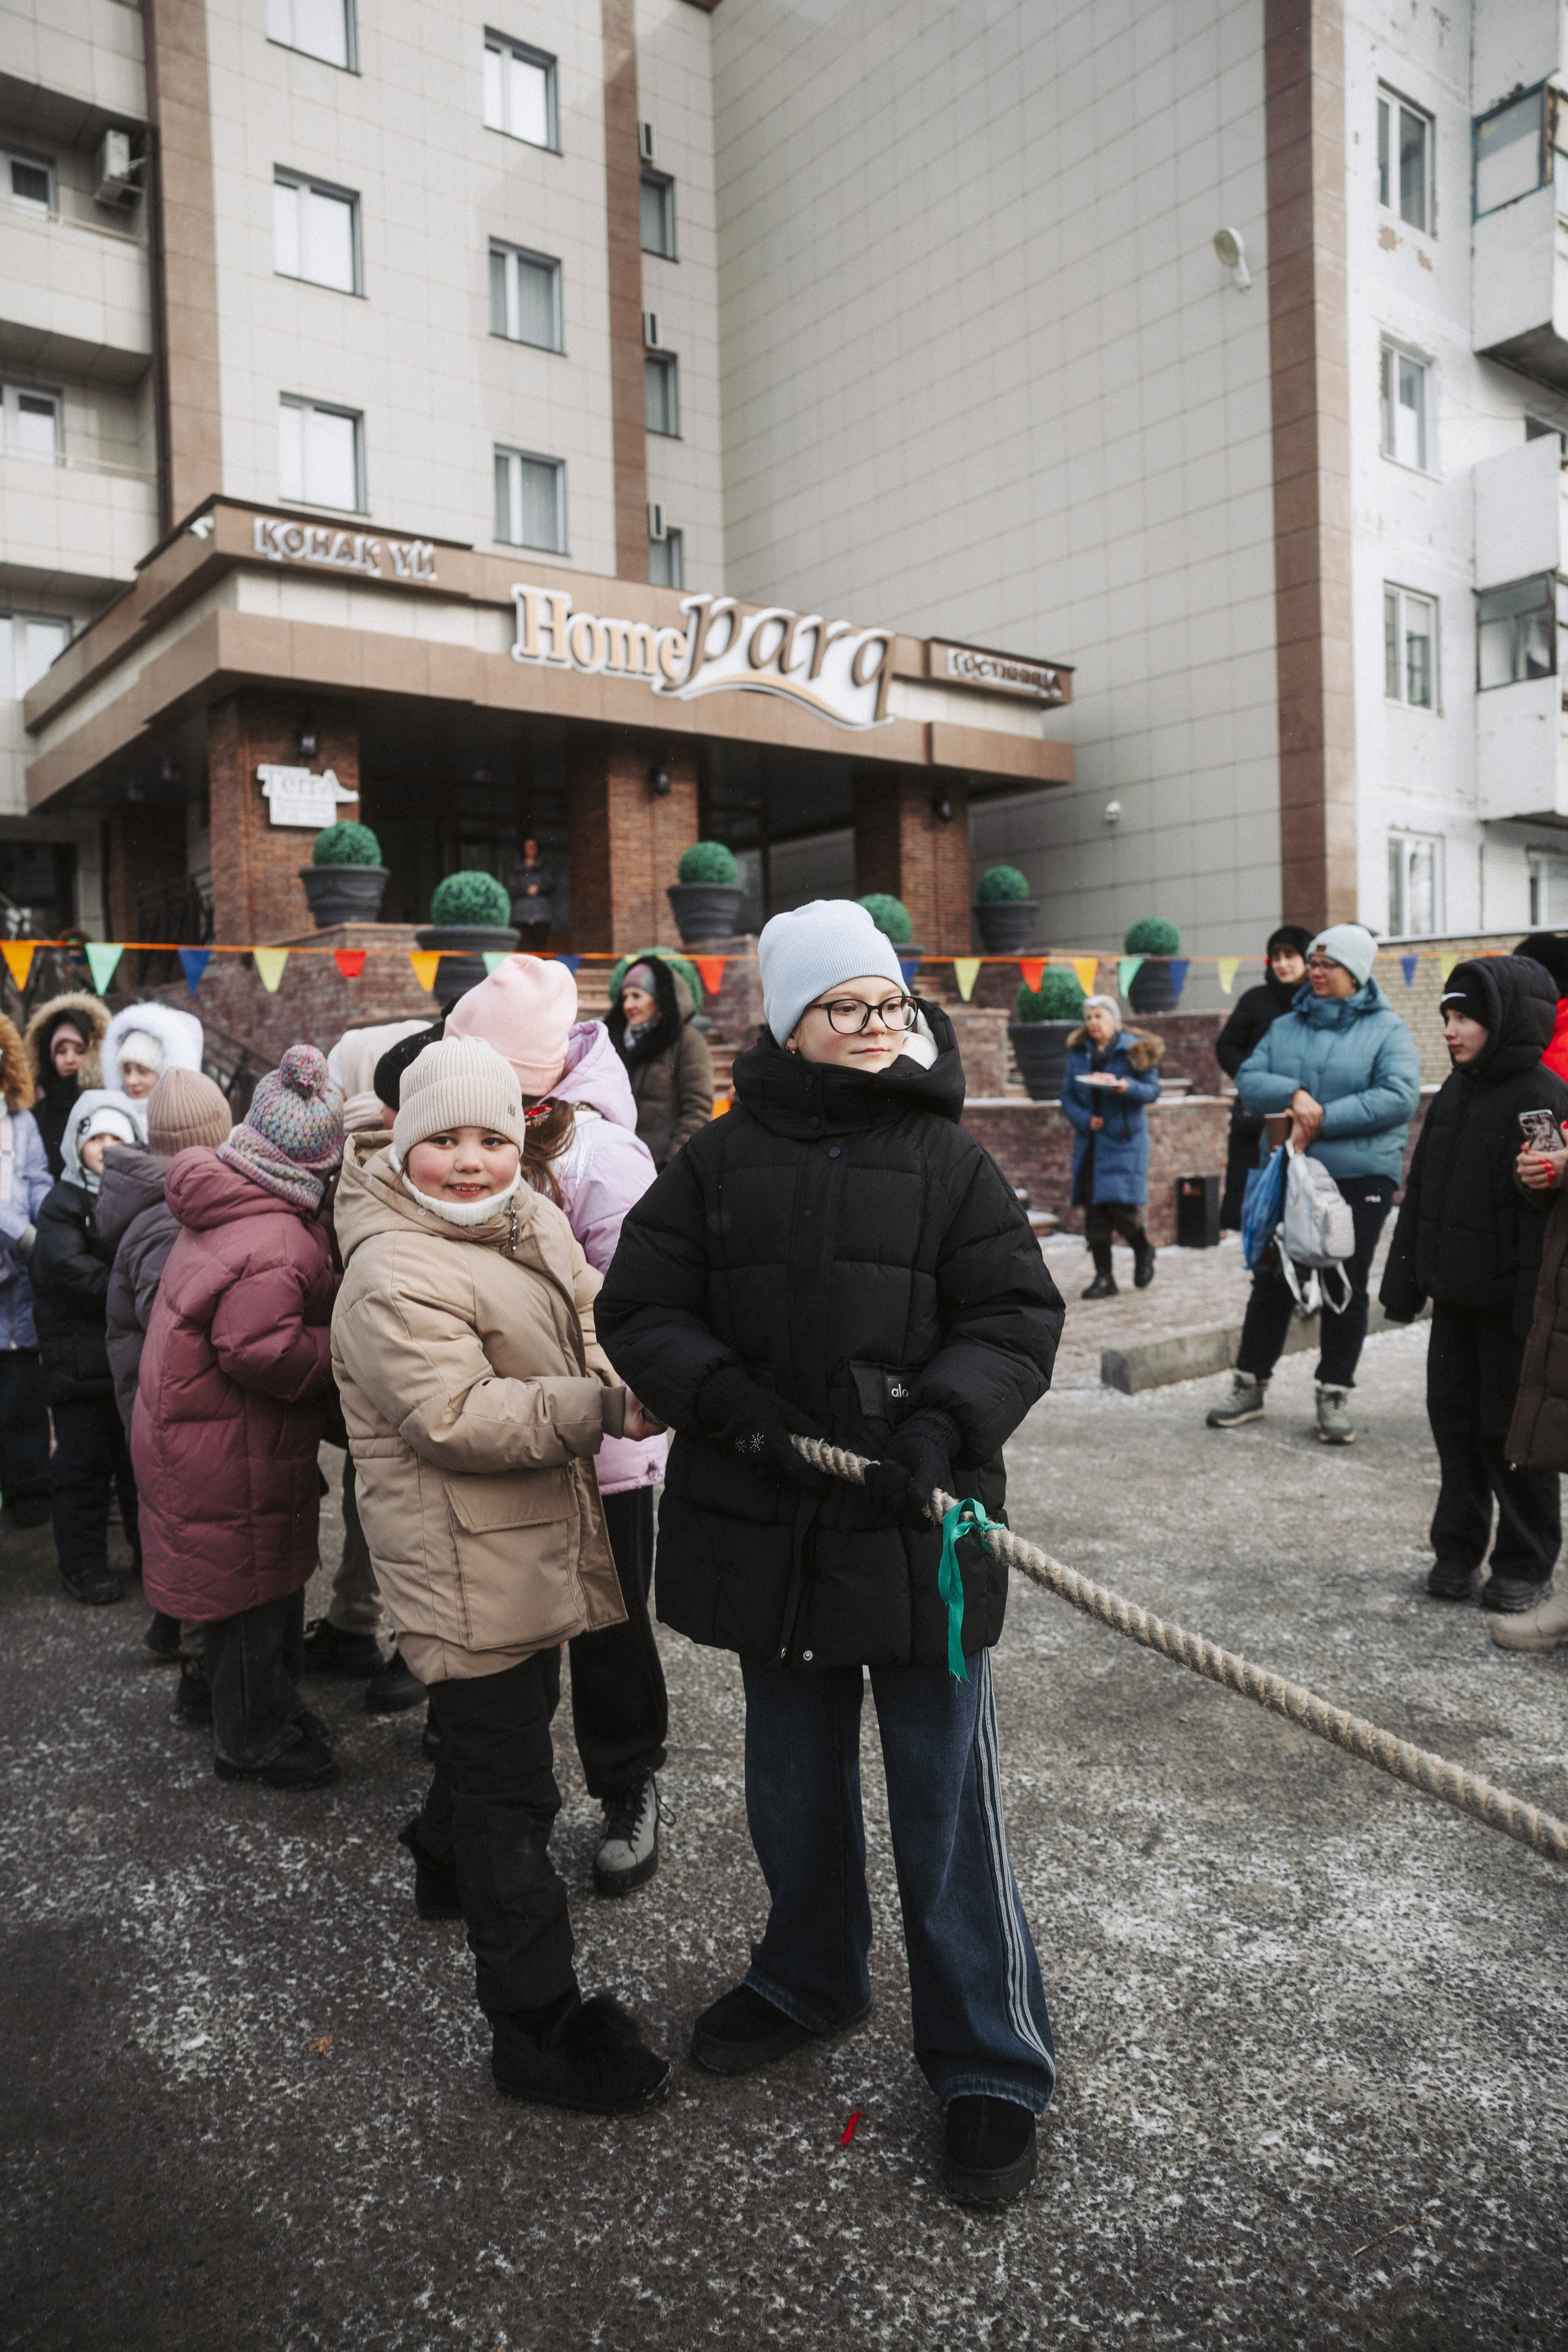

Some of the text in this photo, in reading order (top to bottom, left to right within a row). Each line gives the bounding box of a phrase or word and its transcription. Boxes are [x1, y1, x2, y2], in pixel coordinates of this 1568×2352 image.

[517, 588, 894, 722] Home parq
[891, 1383, 909, 1398] alo
